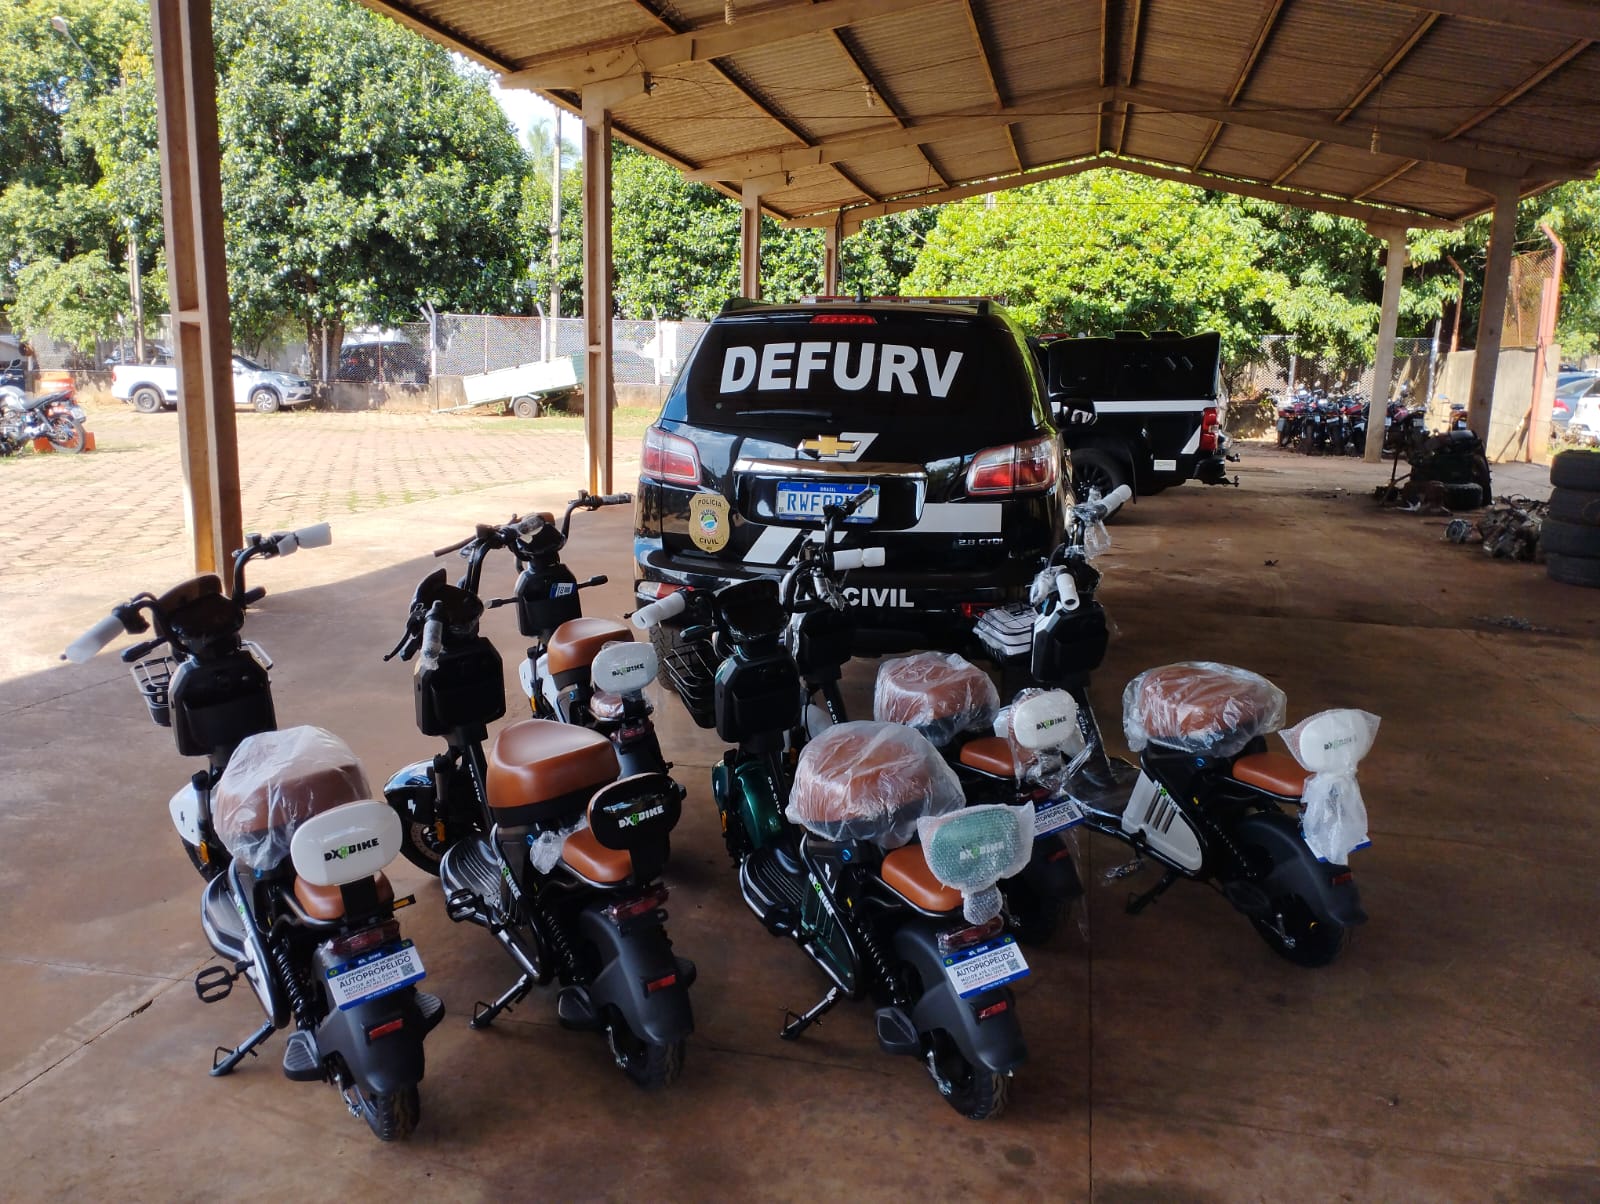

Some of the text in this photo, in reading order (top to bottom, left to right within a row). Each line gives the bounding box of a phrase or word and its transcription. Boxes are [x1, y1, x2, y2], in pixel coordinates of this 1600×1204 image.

[719, 341, 964, 398] DEFURV
[699, 537, 720, 545] CIVIL
[842, 587, 915, 608] CIVIL
[339, 955, 412, 989] AUTOPROPELIDO
[956, 951, 1015, 977] AUTOPROPELIDO
